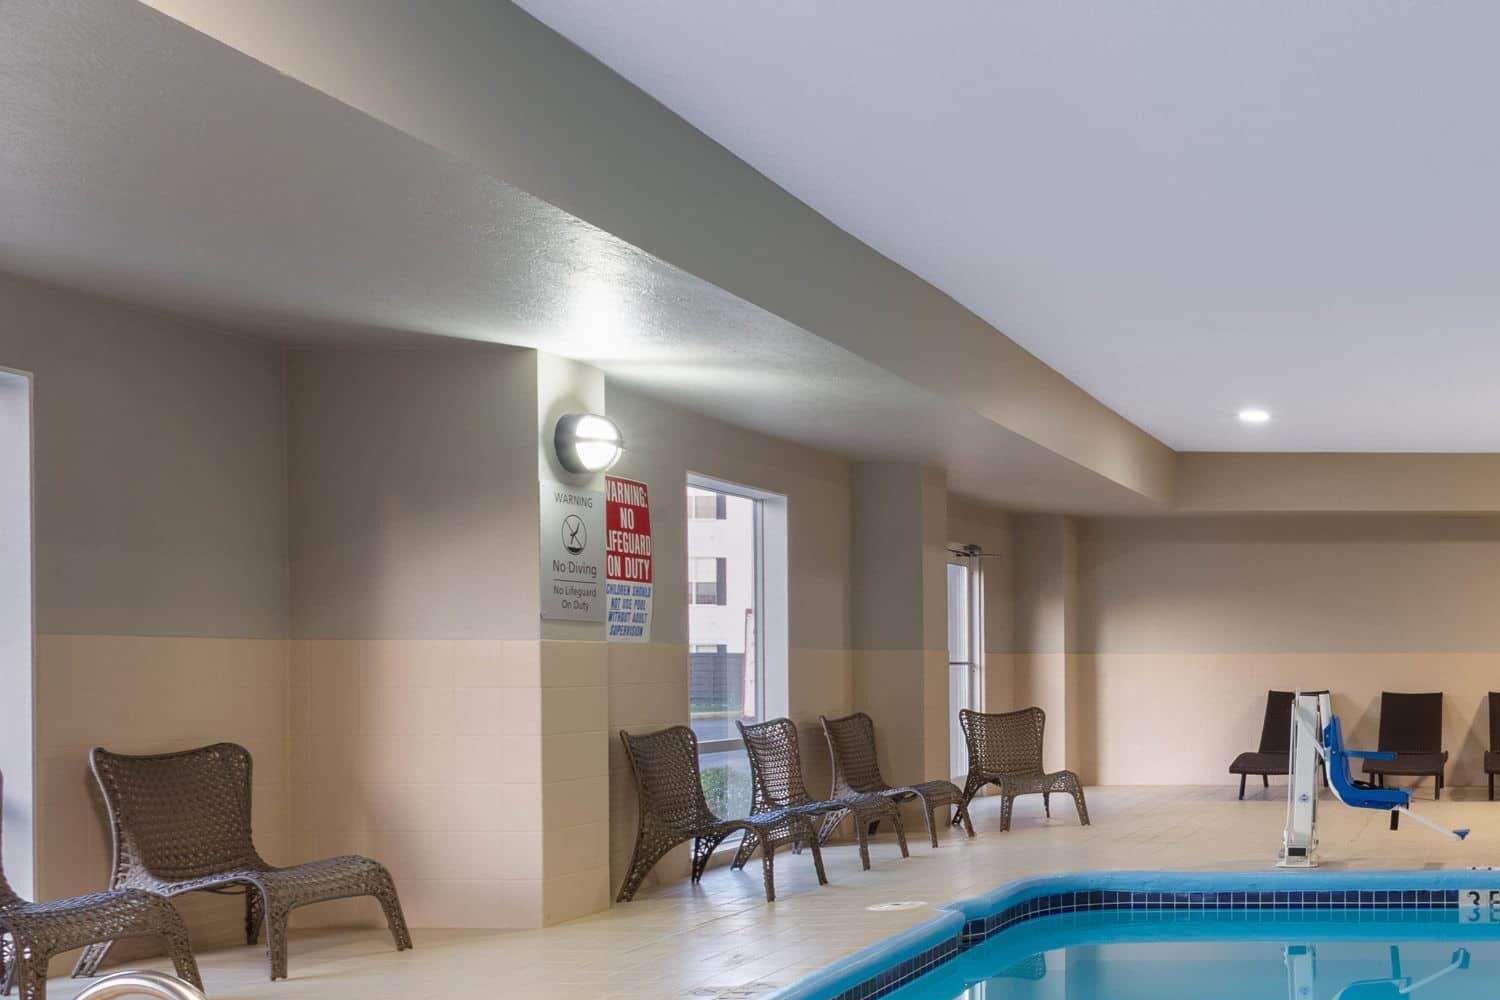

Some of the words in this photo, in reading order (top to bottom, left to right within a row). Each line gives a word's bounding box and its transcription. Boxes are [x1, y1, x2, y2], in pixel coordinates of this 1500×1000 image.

[555, 492, 592, 508] WARNING
[620, 507, 634, 529] NO
[553, 559, 566, 573] No
[568, 561, 597, 579] Diving
[607, 554, 621, 577] ON
[625, 556, 650, 580] DUTY
[553, 584, 564, 595] No
[565, 585, 597, 599] Lifeguard
[561, 600, 572, 609] On
[573, 600, 589, 613] Duty
[1468, 890, 1480, 906] 3
